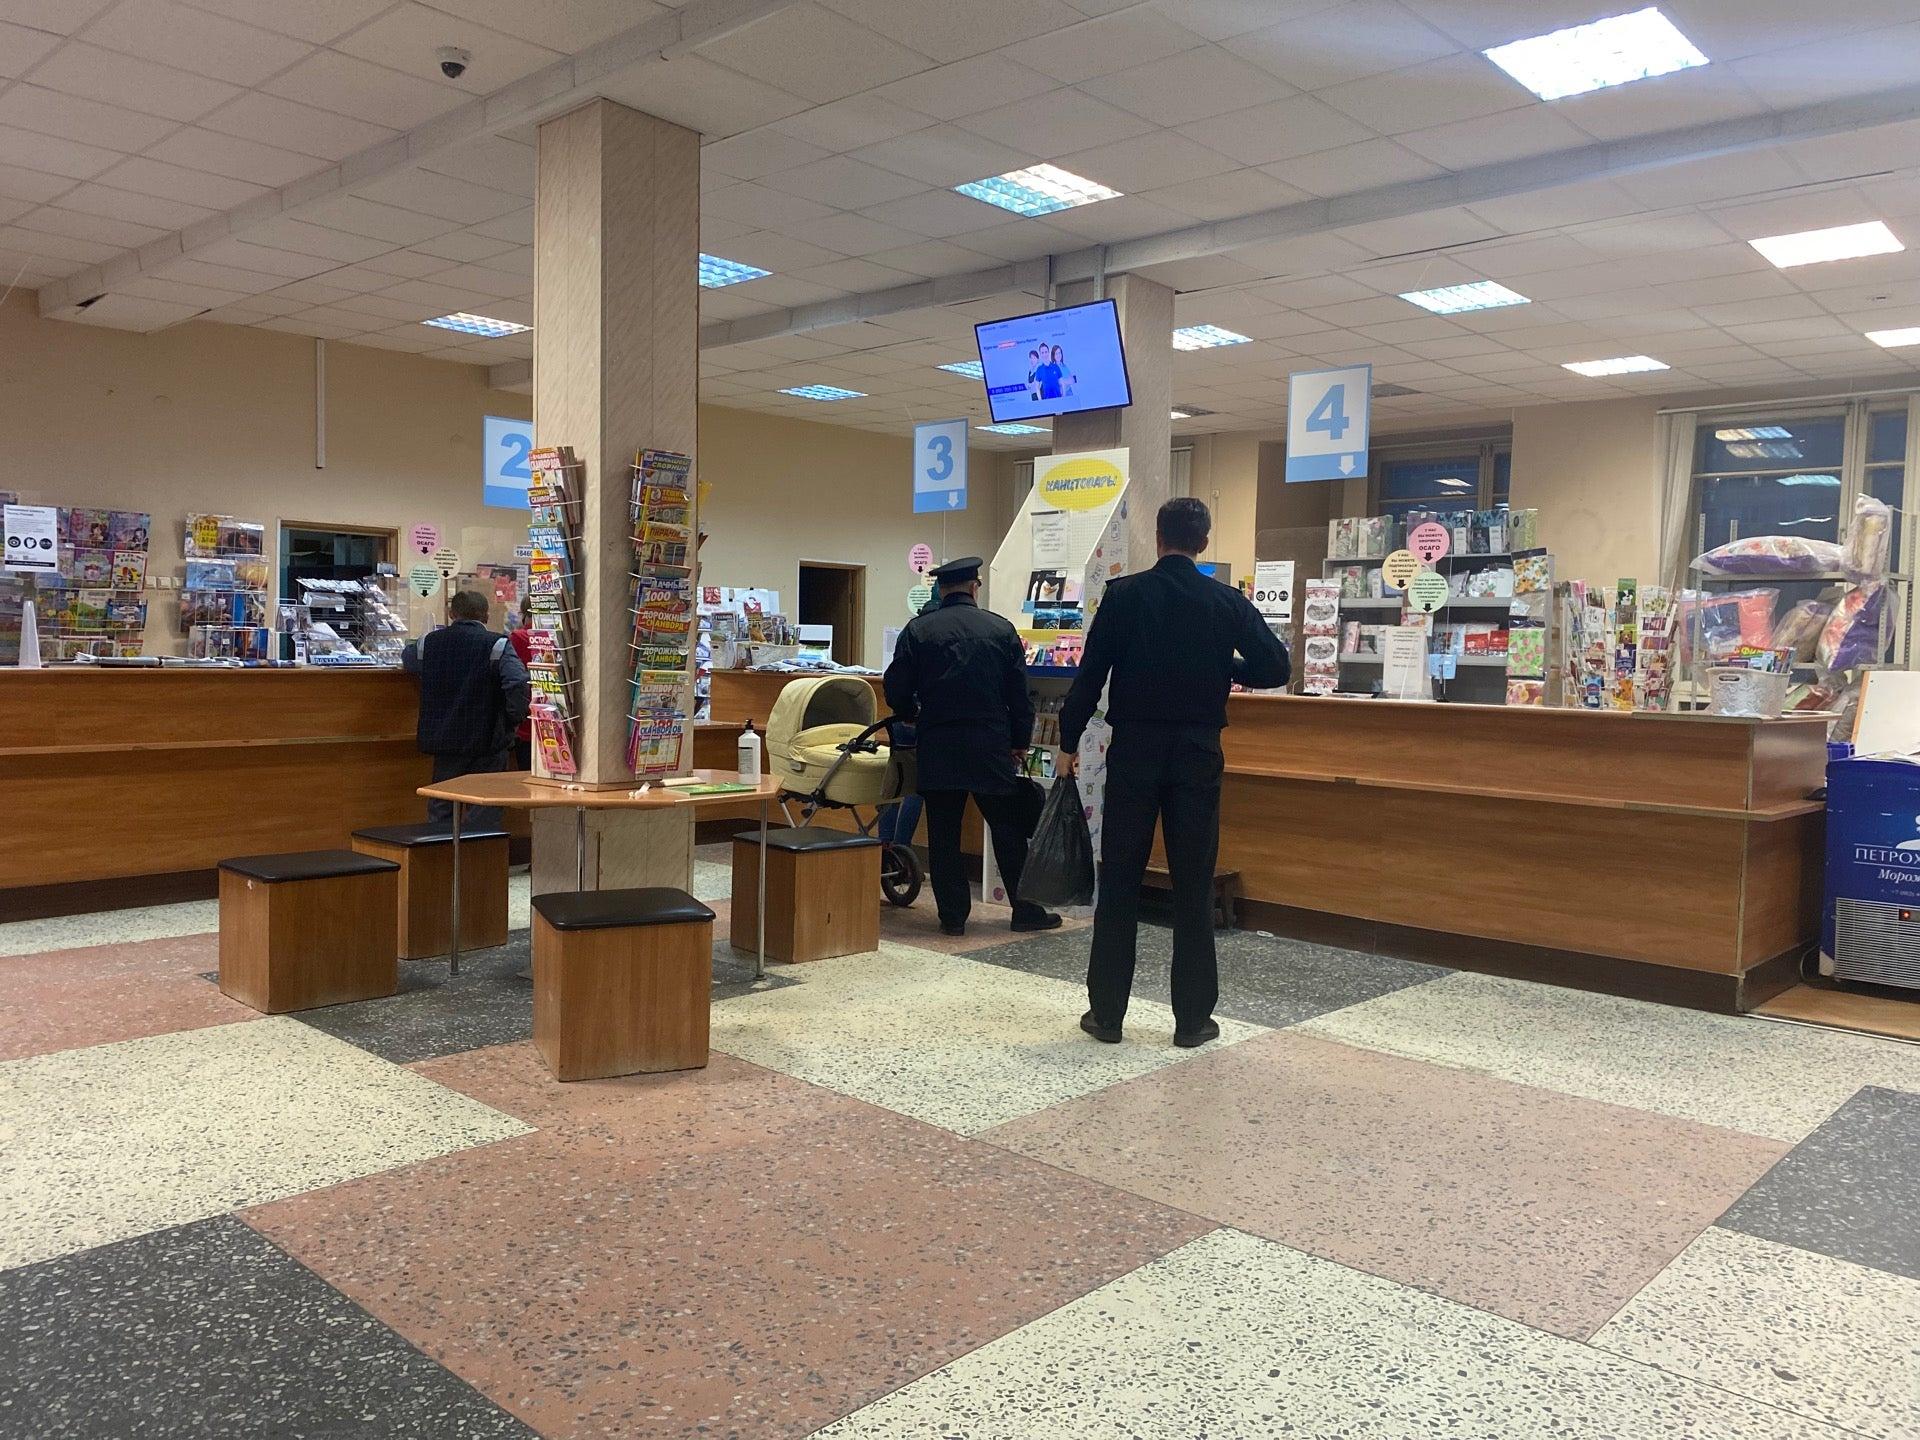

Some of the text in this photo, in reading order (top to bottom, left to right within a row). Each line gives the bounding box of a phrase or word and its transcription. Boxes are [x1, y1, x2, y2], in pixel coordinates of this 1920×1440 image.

[1306, 384, 1350, 440] 4
[501, 433, 532, 479] 2
[927, 435, 953, 481] 3
[1046, 475, 1118, 492] КАНЦТОВАРЫ
[644, 591, 671, 602] 1000
[642, 611, 681, 621] ДОРОЖН
[646, 620, 684, 631] СКАНВОРД
